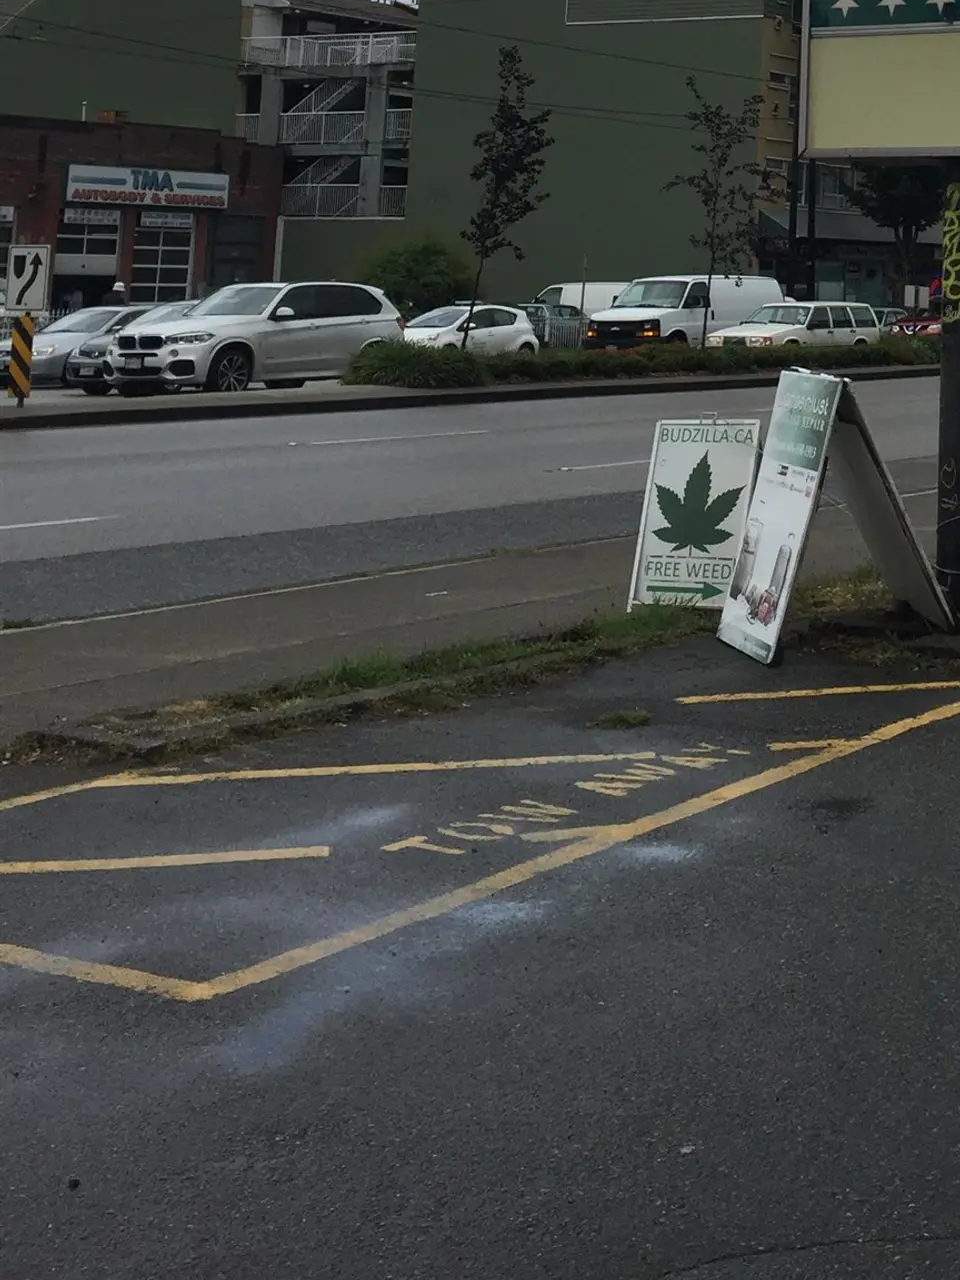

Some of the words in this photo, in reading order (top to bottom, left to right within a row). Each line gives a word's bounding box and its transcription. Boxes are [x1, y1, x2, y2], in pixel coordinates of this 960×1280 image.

[131, 169, 174, 192] TMA
[72, 188, 147, 203] AUTOBODY
[151, 193, 161, 204] &
[164, 194, 225, 207] SERVICES
[660, 427, 755, 445] BUDZILLA.CA
[646, 560, 680, 578] FREE
[685, 561, 732, 580] WEED
[380, 799, 579, 854] TOW
